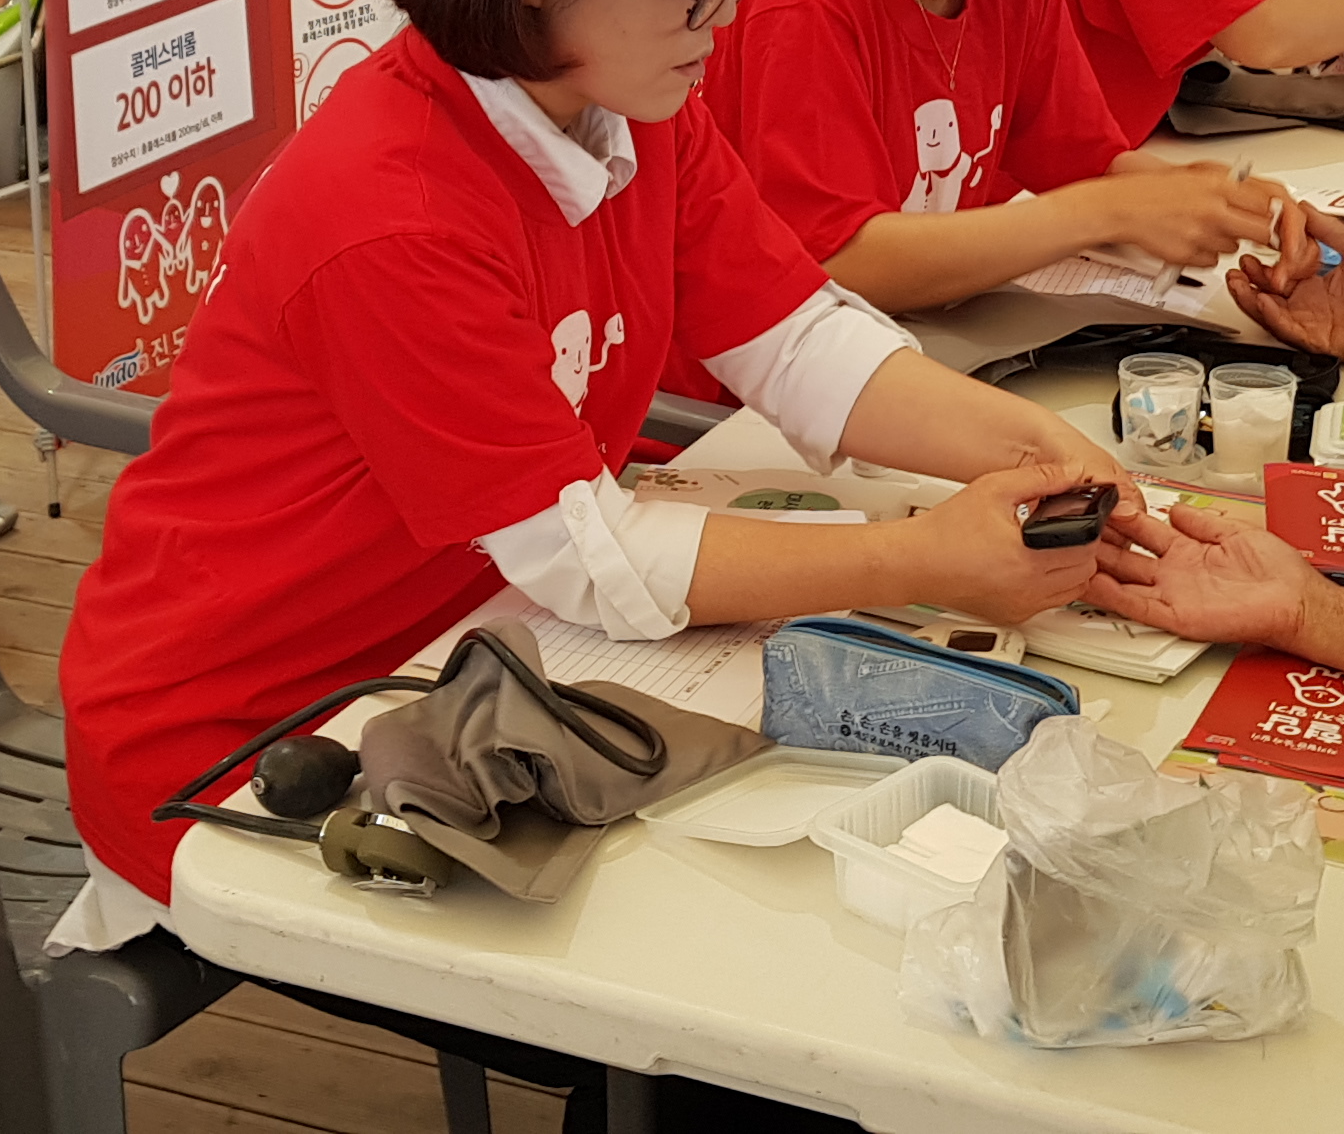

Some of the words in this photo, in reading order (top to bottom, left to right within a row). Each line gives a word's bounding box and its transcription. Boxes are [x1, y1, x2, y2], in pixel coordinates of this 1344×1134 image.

[129, 30, 197, 78] 콜레스테롤
[115, 79, 161, 133] 200
[167, 53, 216, 109] 이하
[1256, 713, 1344, 745] 혈압
